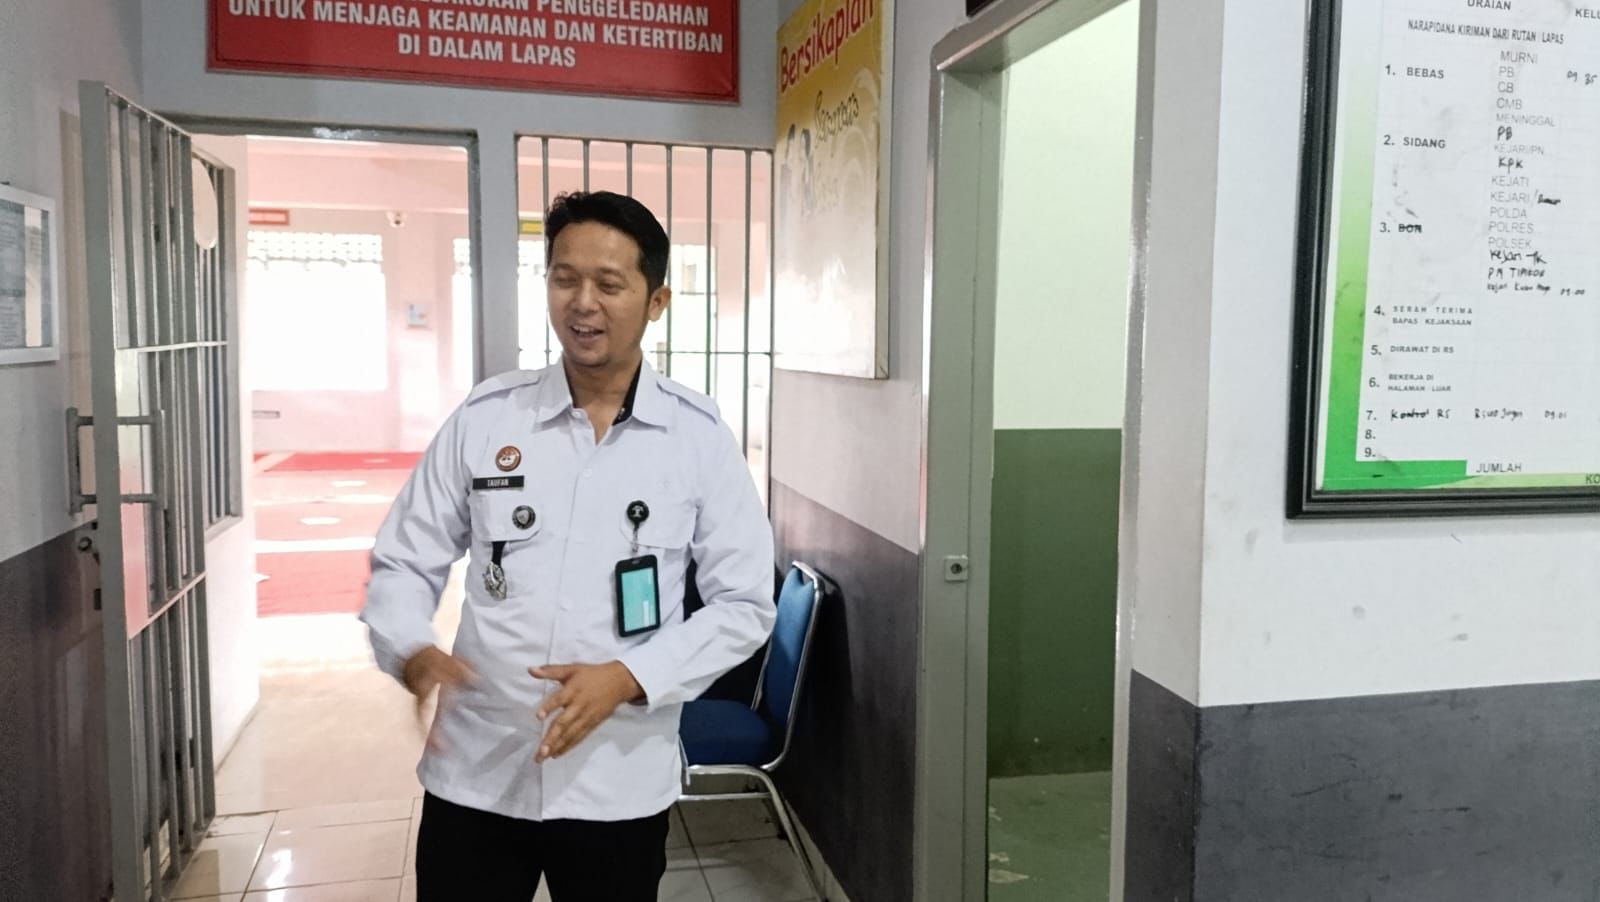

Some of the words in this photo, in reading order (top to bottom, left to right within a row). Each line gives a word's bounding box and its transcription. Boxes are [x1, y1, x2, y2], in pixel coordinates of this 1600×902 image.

[1467, 0, 1512, 11] URAIAN
[537, 0, 709, 26] PENGGELEDAHAN
[229, 0, 306, 20] UNTUK
[313, 1, 421, 29] MENJAGA
[428, 8, 547, 39] KEAMANAN
[554, 19, 596, 43] DAN
[603, 24, 724, 53] KETERTIBAN
[1408, 19, 1456, 35] NARAPIDANA
[1458, 24, 1490, 39] KIRIMAN
[1492, 28, 1510, 41] DARI
[1511, 29, 1537, 43] RUTAN
[1541, 32, 1565, 45] LAPAS
[398, 33, 421, 55] DI
[428, 35, 504, 62] DALAM
[511, 42, 576, 67] LAPAS
[1500, 51, 1538, 64] MURNI
[1385, 64, 1396, 76] 1.
[1406, 67, 1445, 79] BEBAS
[1499, 66, 1515, 78] PB
[1496, 97, 1523, 109] CMB
[1496, 113, 1556, 127] MENINGGAL
[1384, 135, 1395, 146] 2.
[1403, 136, 1446, 149] SIDANG
[1491, 175, 1530, 187] KEJATI
[1490, 206, 1528, 218] POLDA
[1379, 222, 1391, 233] 3.
[1488, 221, 1535, 234] POLRES
[1488, 236, 1532, 249] POLSEK
[1373, 305, 1385, 316] 4.
[1436, 307, 1473, 315] TERIMA
[1392, 317, 1418, 325] BAPAS
[1425, 318, 1472, 326] KEJAKSAAN
[1370, 345, 1382, 356] 5.
[1390, 345, 1429, 353] DIRAWAT
[1368, 377, 1380, 388] 6.
[1366, 410, 1377, 421] 7.
[1365, 429, 1376, 440] 8.
[1364, 447, 1376, 458] 9.
[1476, 463, 1522, 473] JUMLAH
